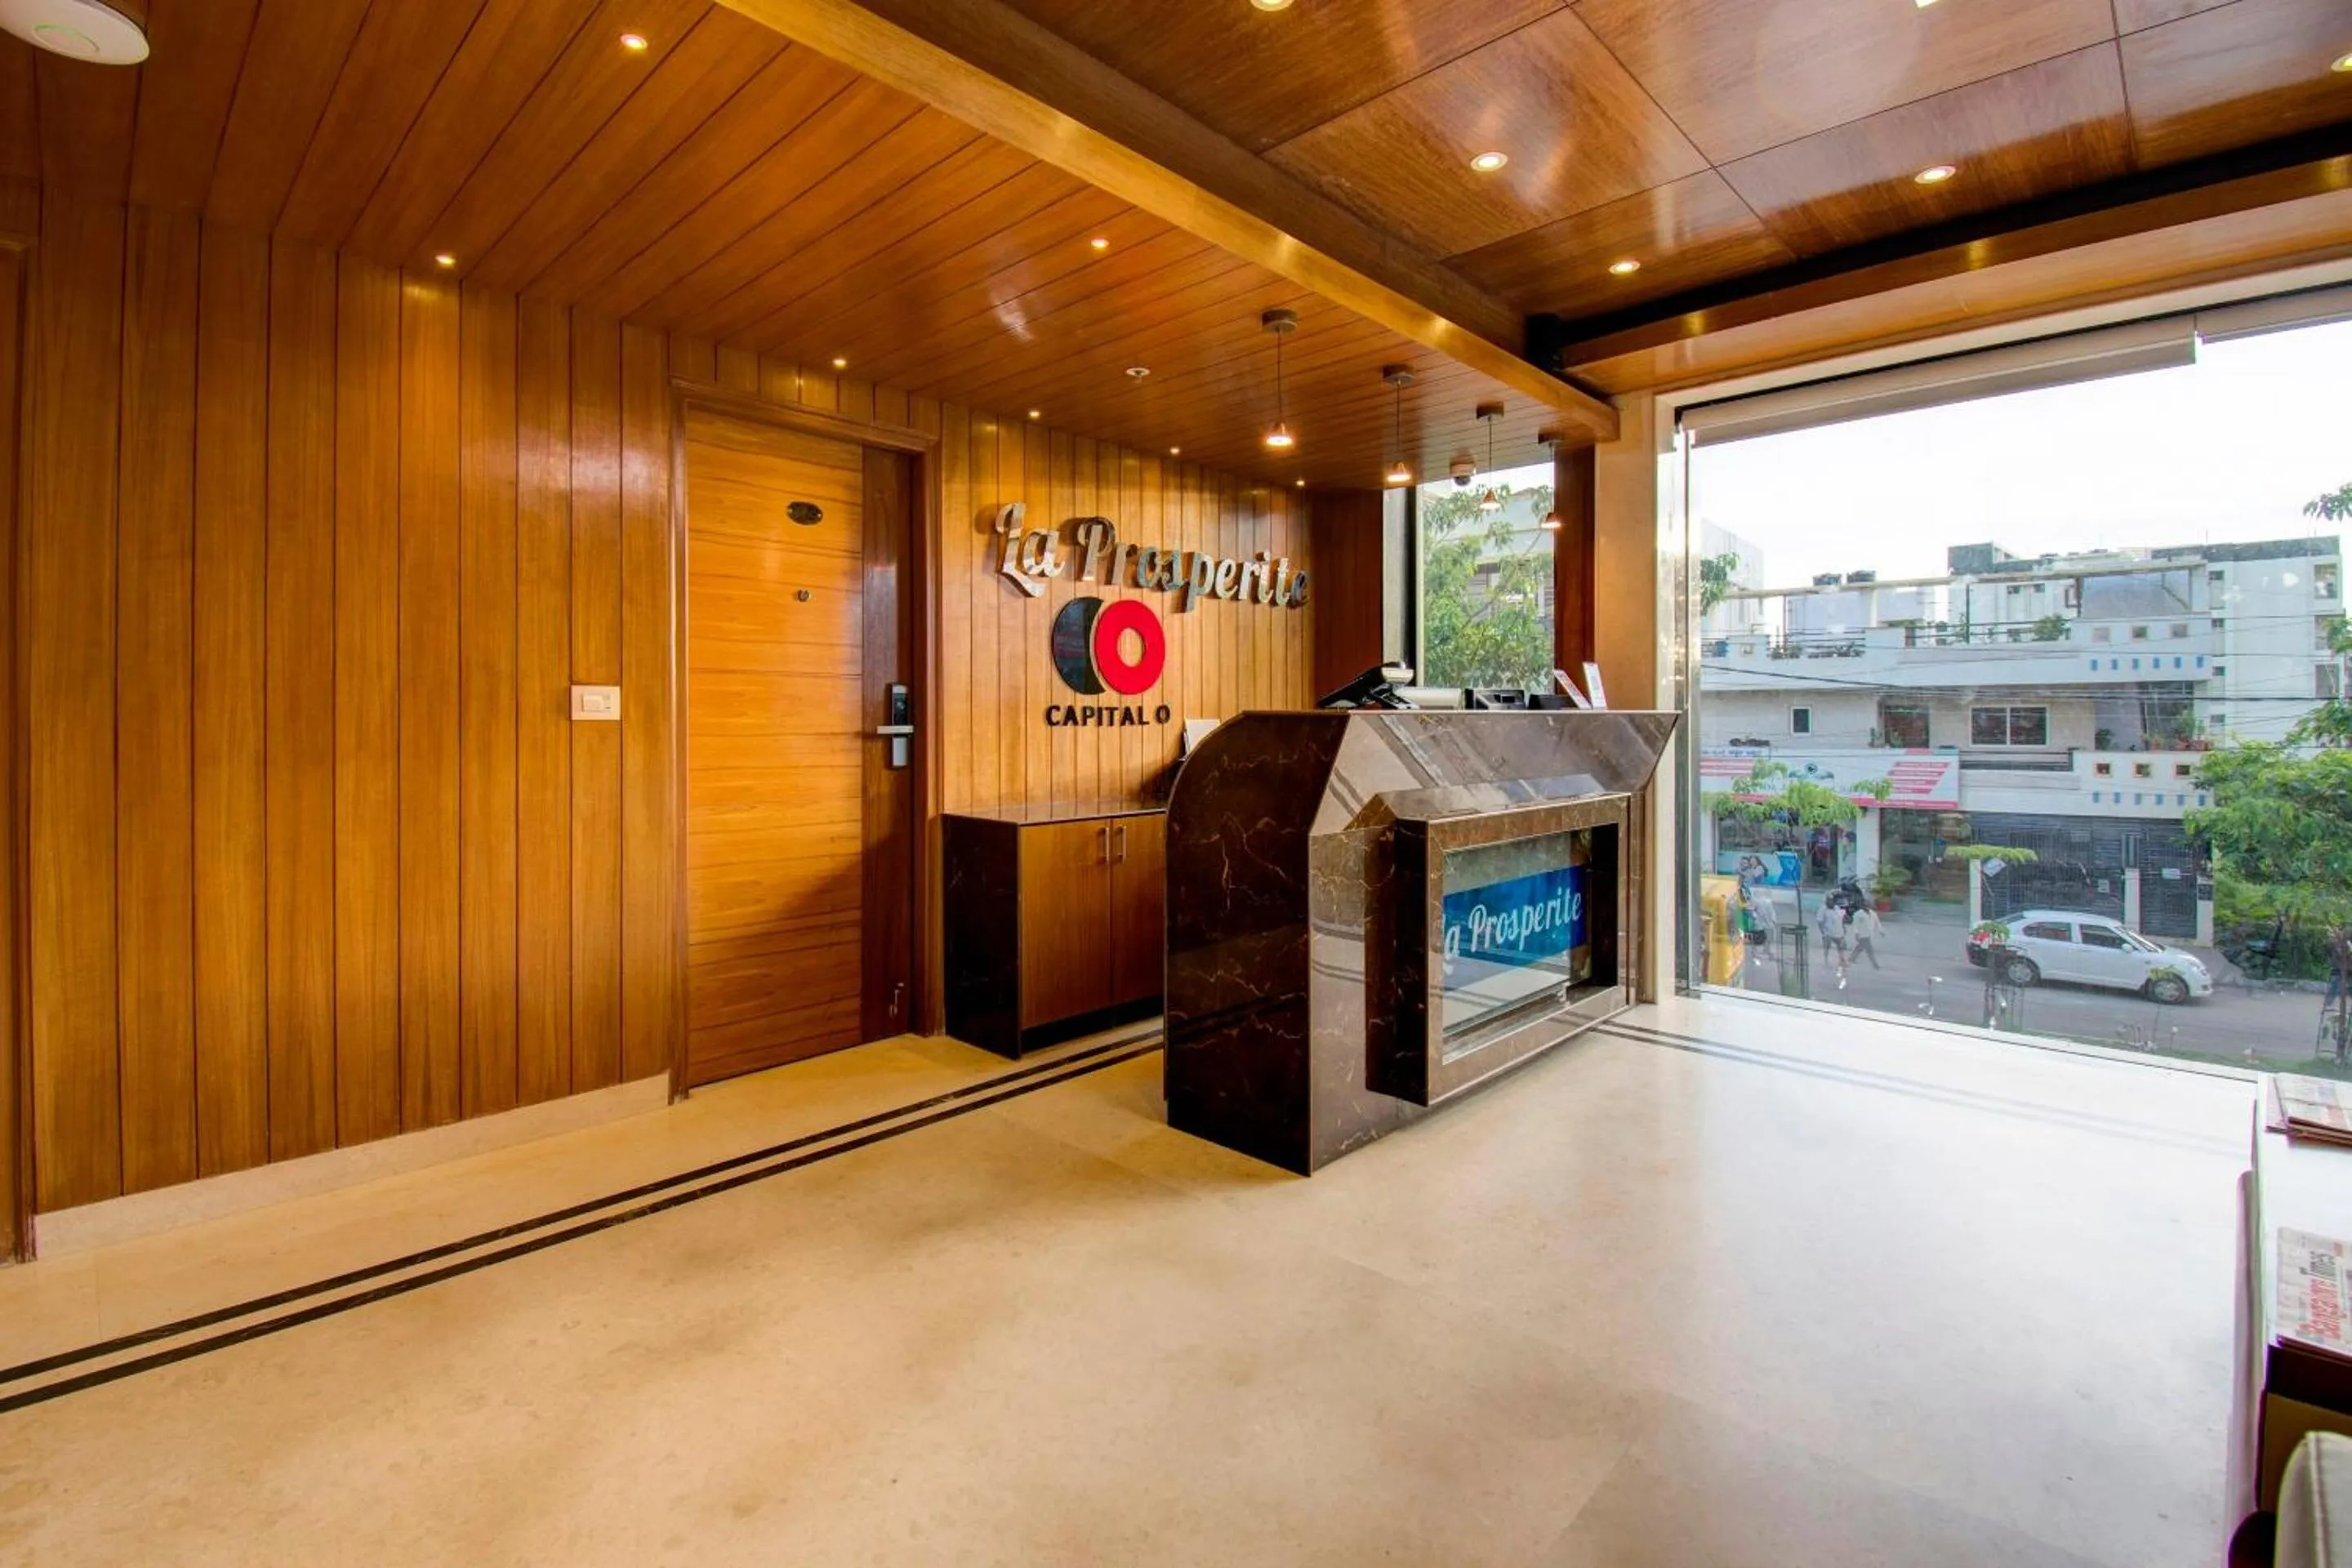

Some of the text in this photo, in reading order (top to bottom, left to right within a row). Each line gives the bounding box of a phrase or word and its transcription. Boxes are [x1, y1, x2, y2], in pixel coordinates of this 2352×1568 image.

[996, 502, 1310, 613] La Prosperite
[1045, 704, 1171, 727] CAPITAL O
[1468, 885, 1583, 953] Prosperite
